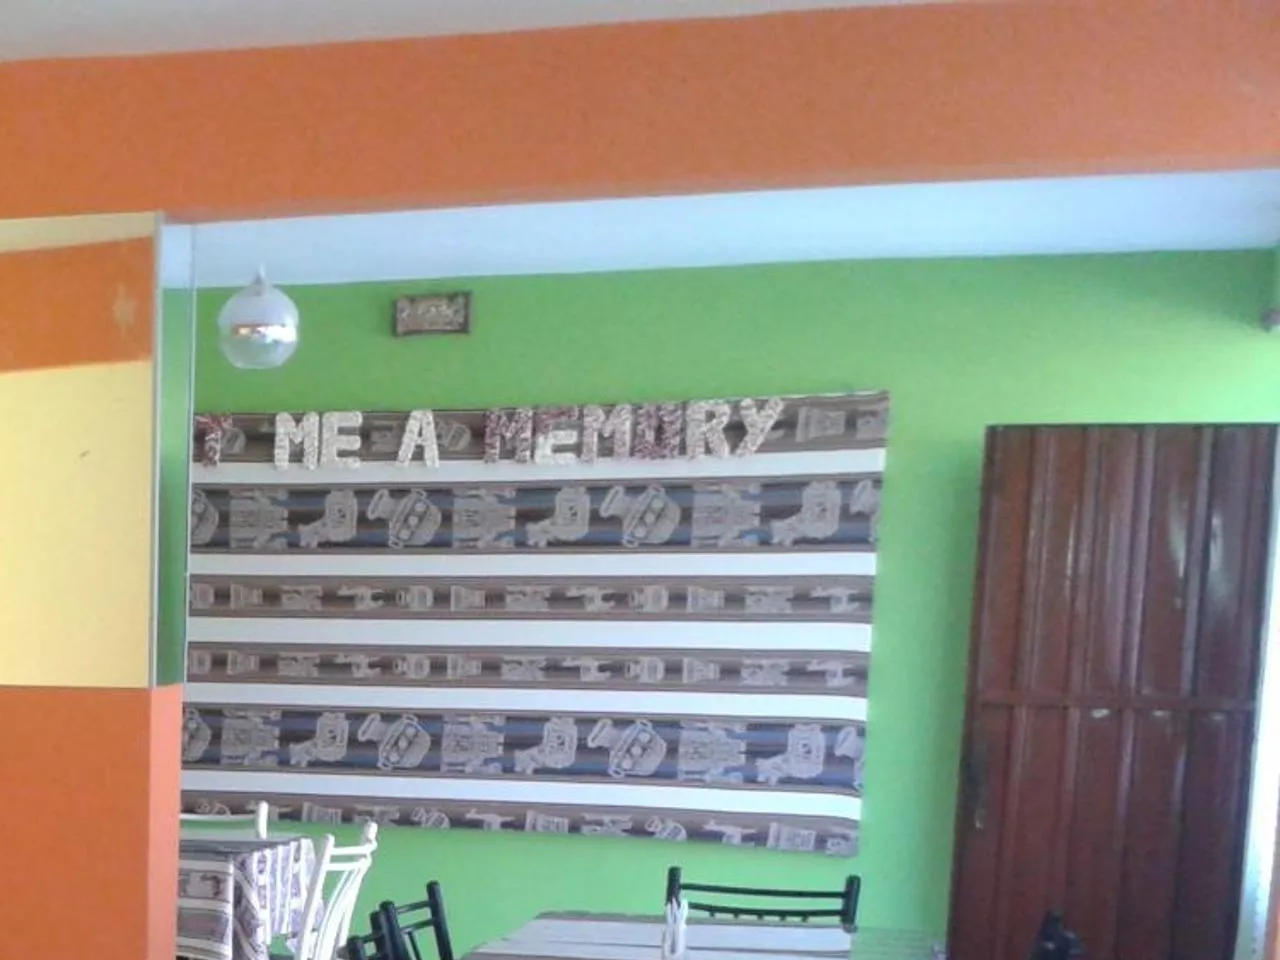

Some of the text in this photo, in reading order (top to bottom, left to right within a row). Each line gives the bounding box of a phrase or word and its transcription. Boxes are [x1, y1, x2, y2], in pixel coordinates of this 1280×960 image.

[273, 410, 363, 470] ME
[395, 408, 440, 469] A
[482, 397, 785, 465] MEMORY
